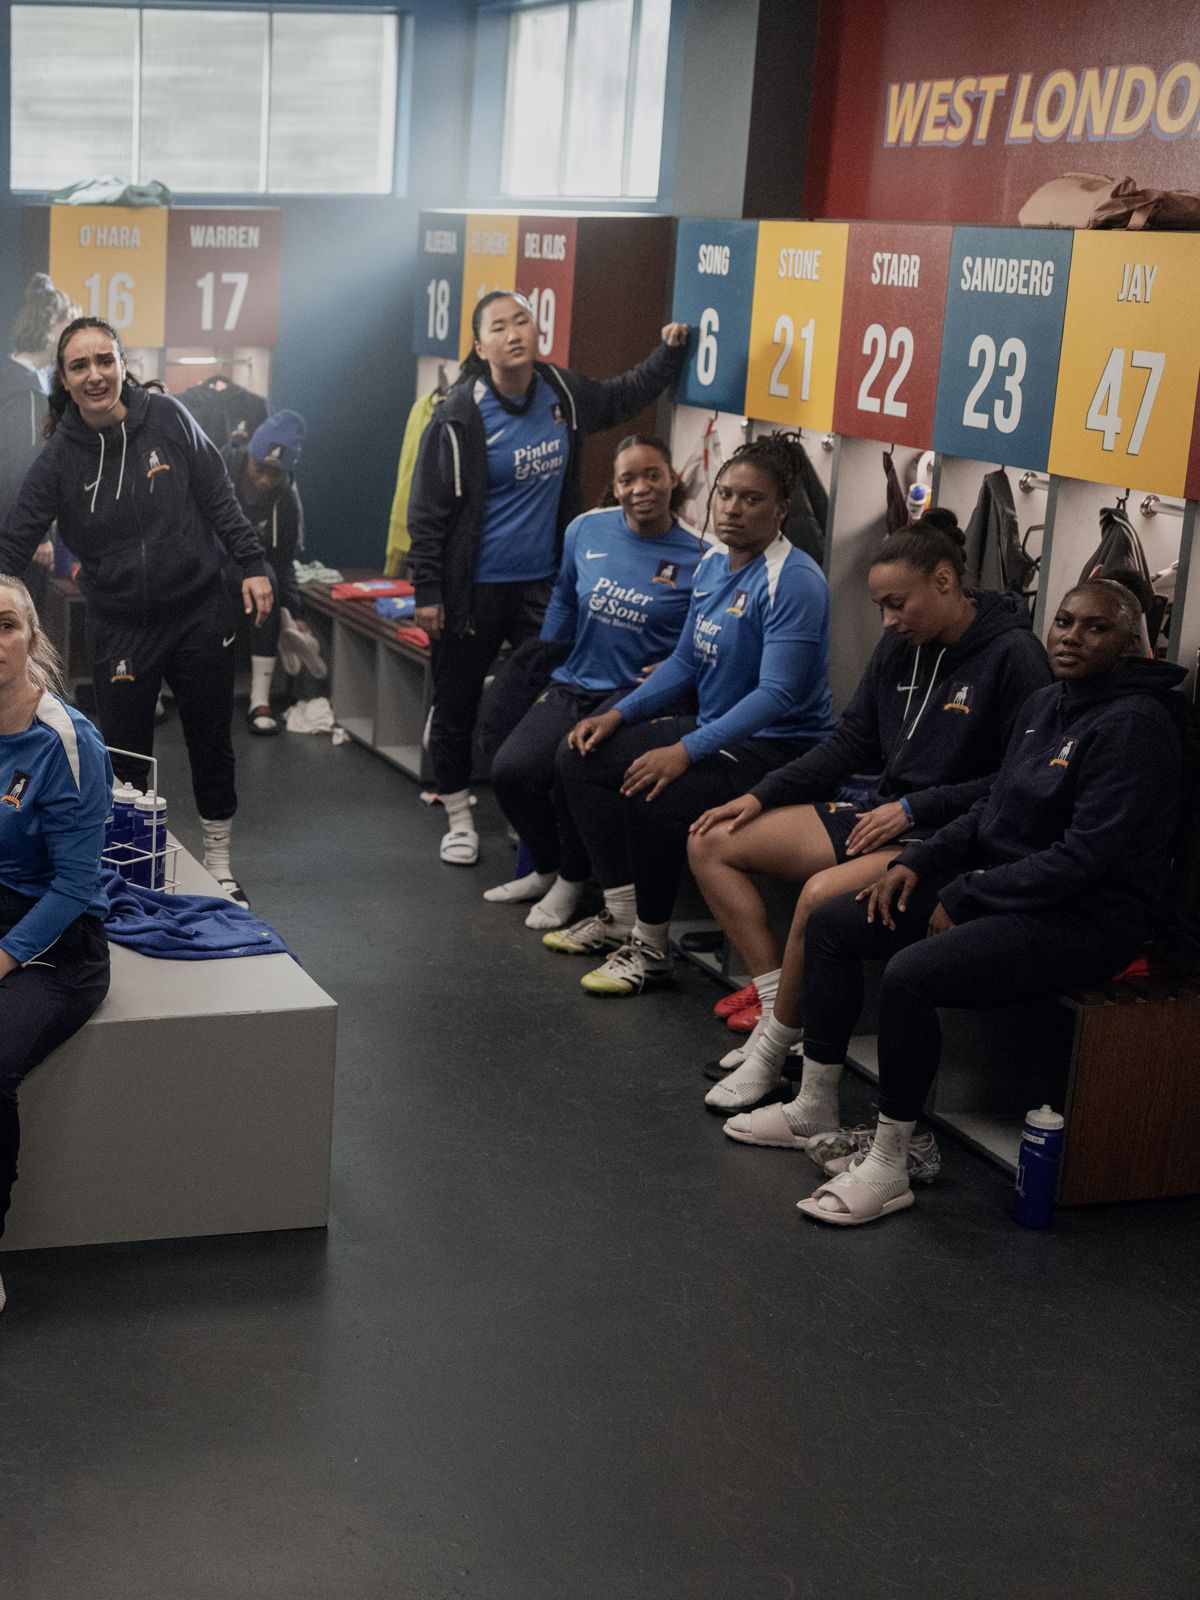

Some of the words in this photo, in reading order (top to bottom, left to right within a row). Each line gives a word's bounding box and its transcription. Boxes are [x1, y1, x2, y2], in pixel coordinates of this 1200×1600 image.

[883, 73, 1010, 148] WEST
[1004, 61, 1200, 145] LONDO
[79, 225, 141, 247] O'HARA
[189, 225, 260, 248] WARREN
[697, 243, 730, 276] SONG
[778, 248, 822, 281] STONE
[870, 251, 921, 288] STARR
[960, 256, 1055, 297] SANDBERG
[1117, 263, 1158, 303] JAY
[84, 271, 135, 330] 16
[196, 271, 249, 331] 17
[427, 278, 450, 341] 18
[696, 307, 720, 386] 6
[768, 314, 816, 401] 21
[856, 323, 915, 418] 22
[962, 333, 1028, 435] 23
[1085, 347, 1166, 456] 47
[513, 438, 561, 466] Pinter
[593, 576, 654, 607] Pinter
